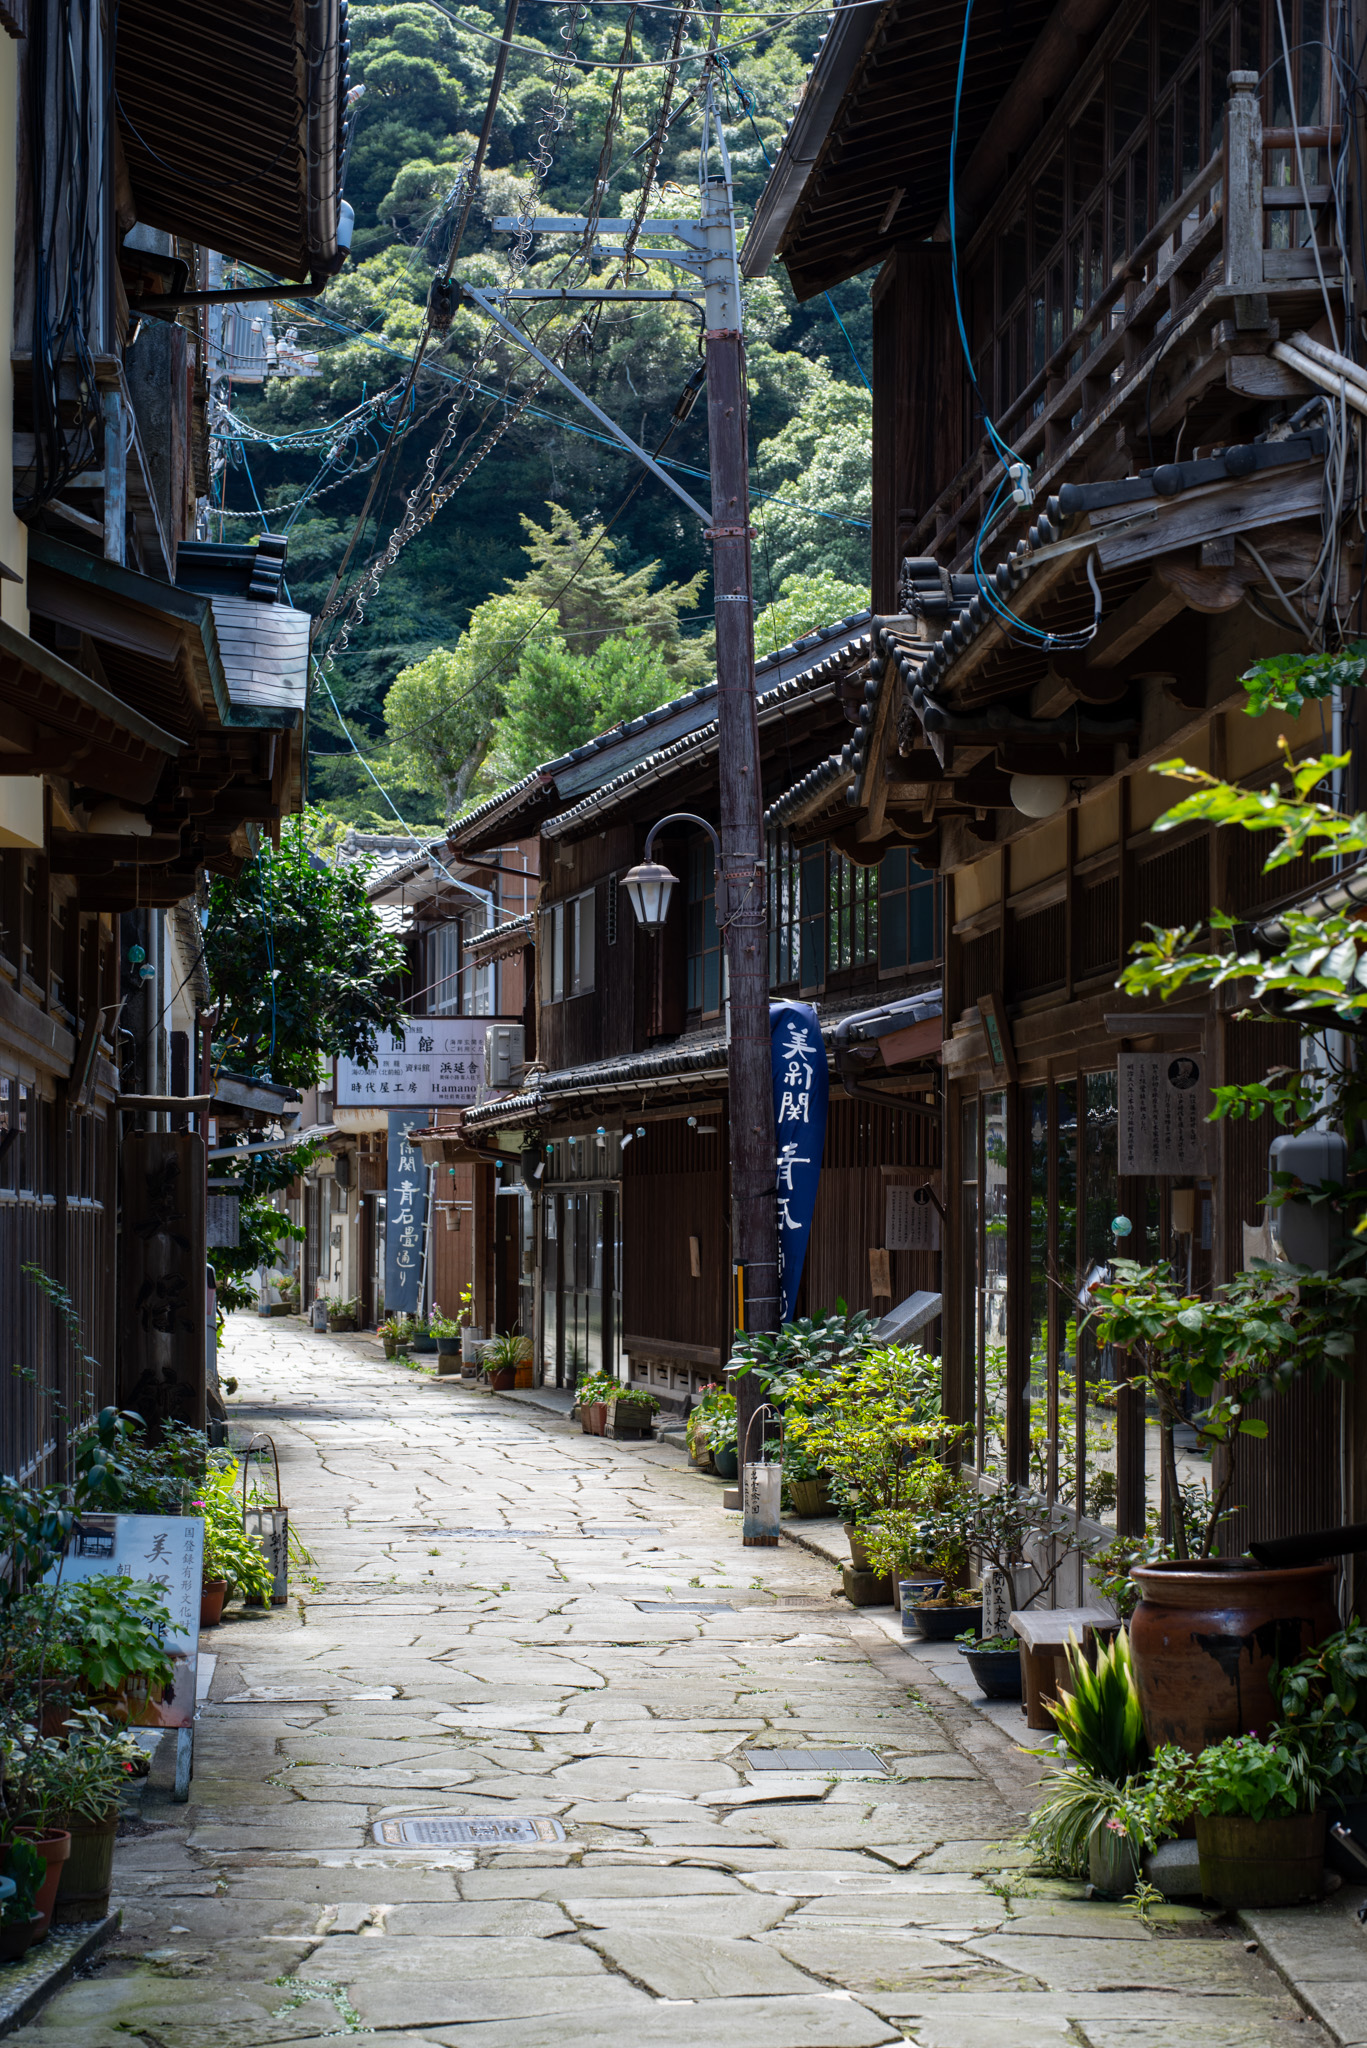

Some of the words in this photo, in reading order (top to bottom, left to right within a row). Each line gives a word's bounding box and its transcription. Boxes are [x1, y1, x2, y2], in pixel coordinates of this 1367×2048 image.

[405, 1063, 431, 1073] 資料館
[351, 1082, 418, 1094] 時代屋工房
[432, 1083, 477, 1093] Hamano
[392, 1180, 420, 1287] 青石畳通り
[179, 1526, 196, 1629] 国登録有形文化財
[992, 1571, 1007, 1633] 関の五本松
